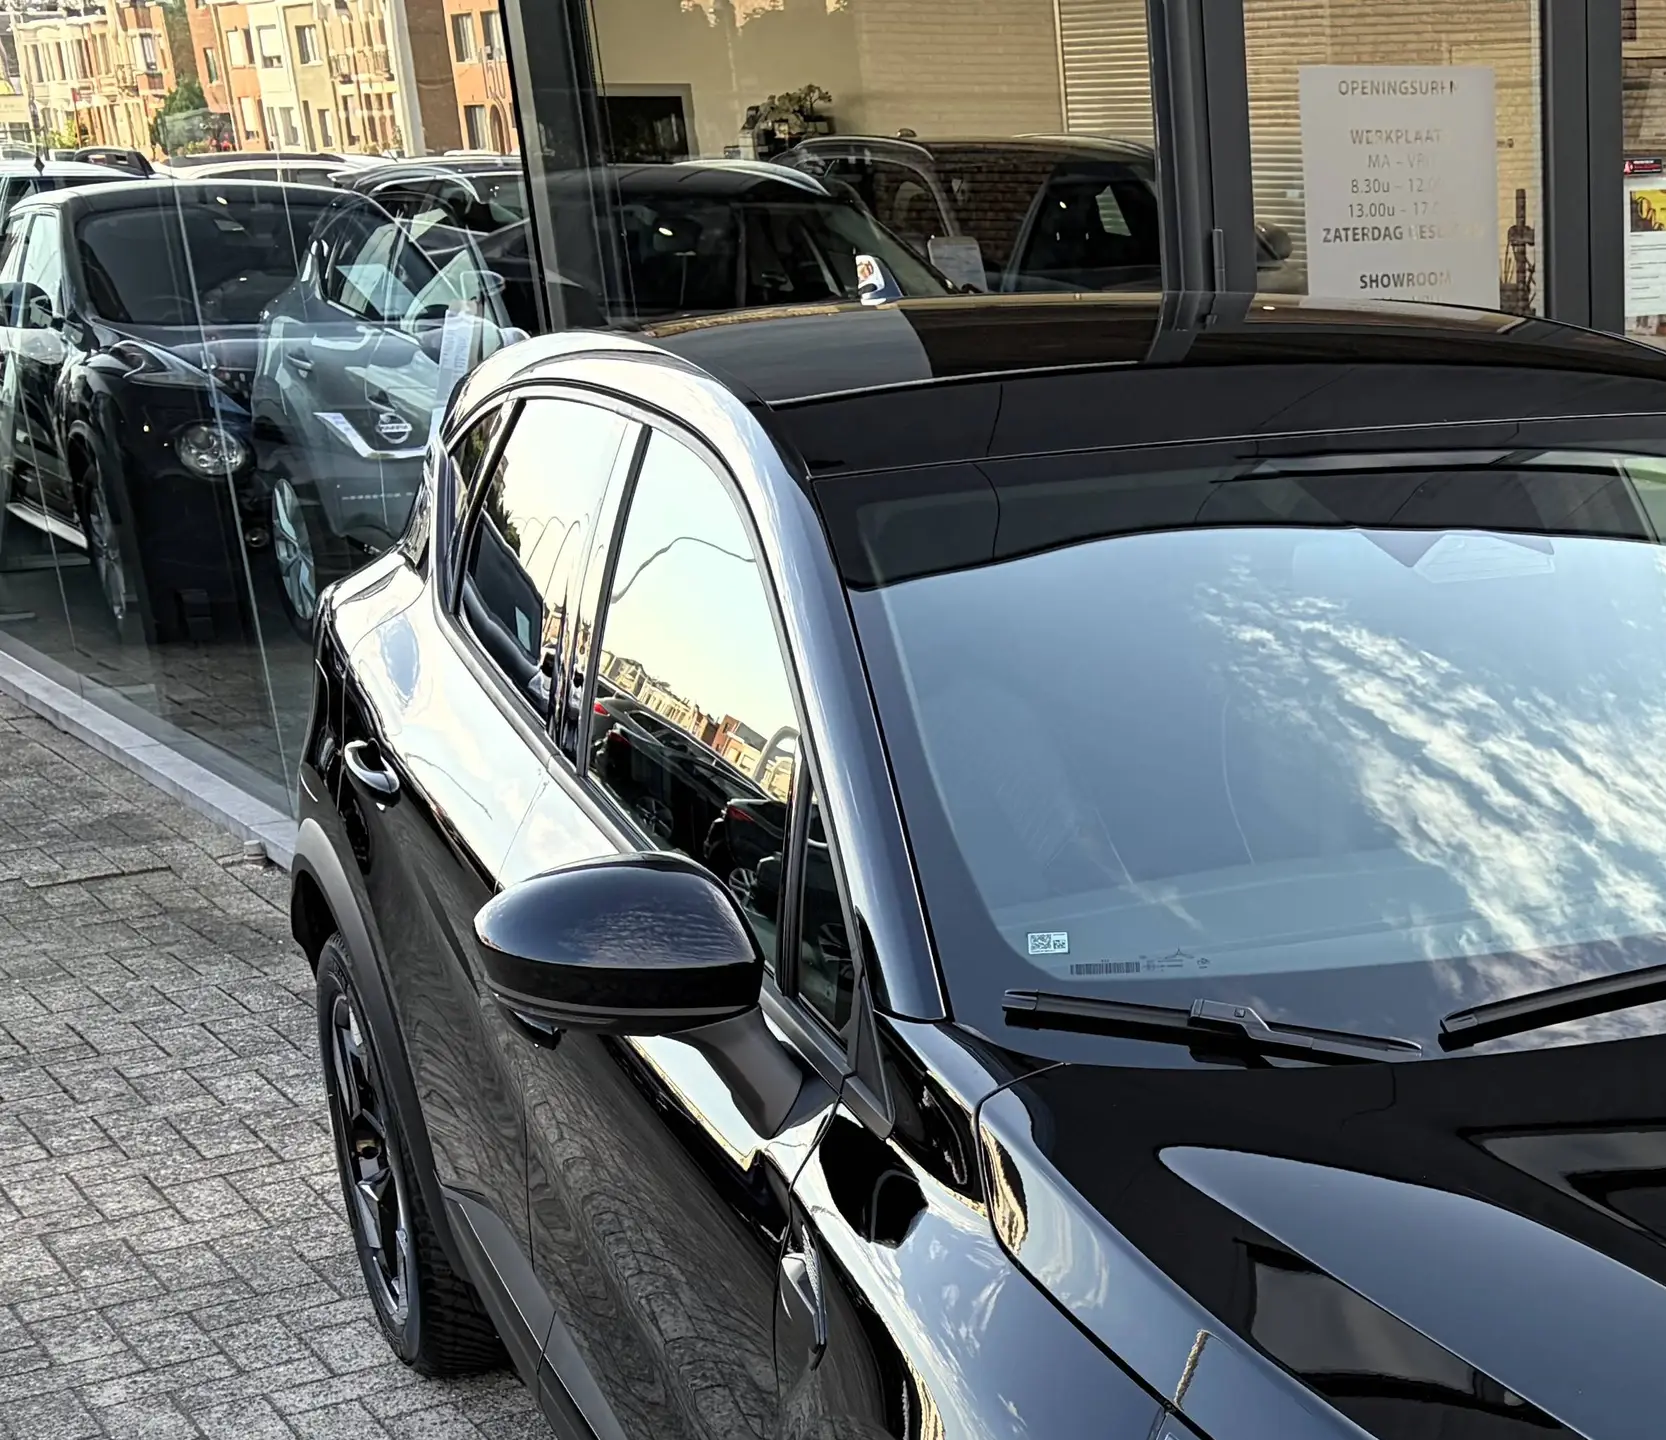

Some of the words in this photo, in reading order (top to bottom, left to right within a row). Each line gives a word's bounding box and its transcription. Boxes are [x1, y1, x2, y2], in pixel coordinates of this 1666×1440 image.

[1368, 154, 1390, 169] MA
[1351, 179, 1390, 194] 8.30u
[1348, 203, 1395, 218] 13.00u
[1322, 226, 1403, 243] ZATERDAG
